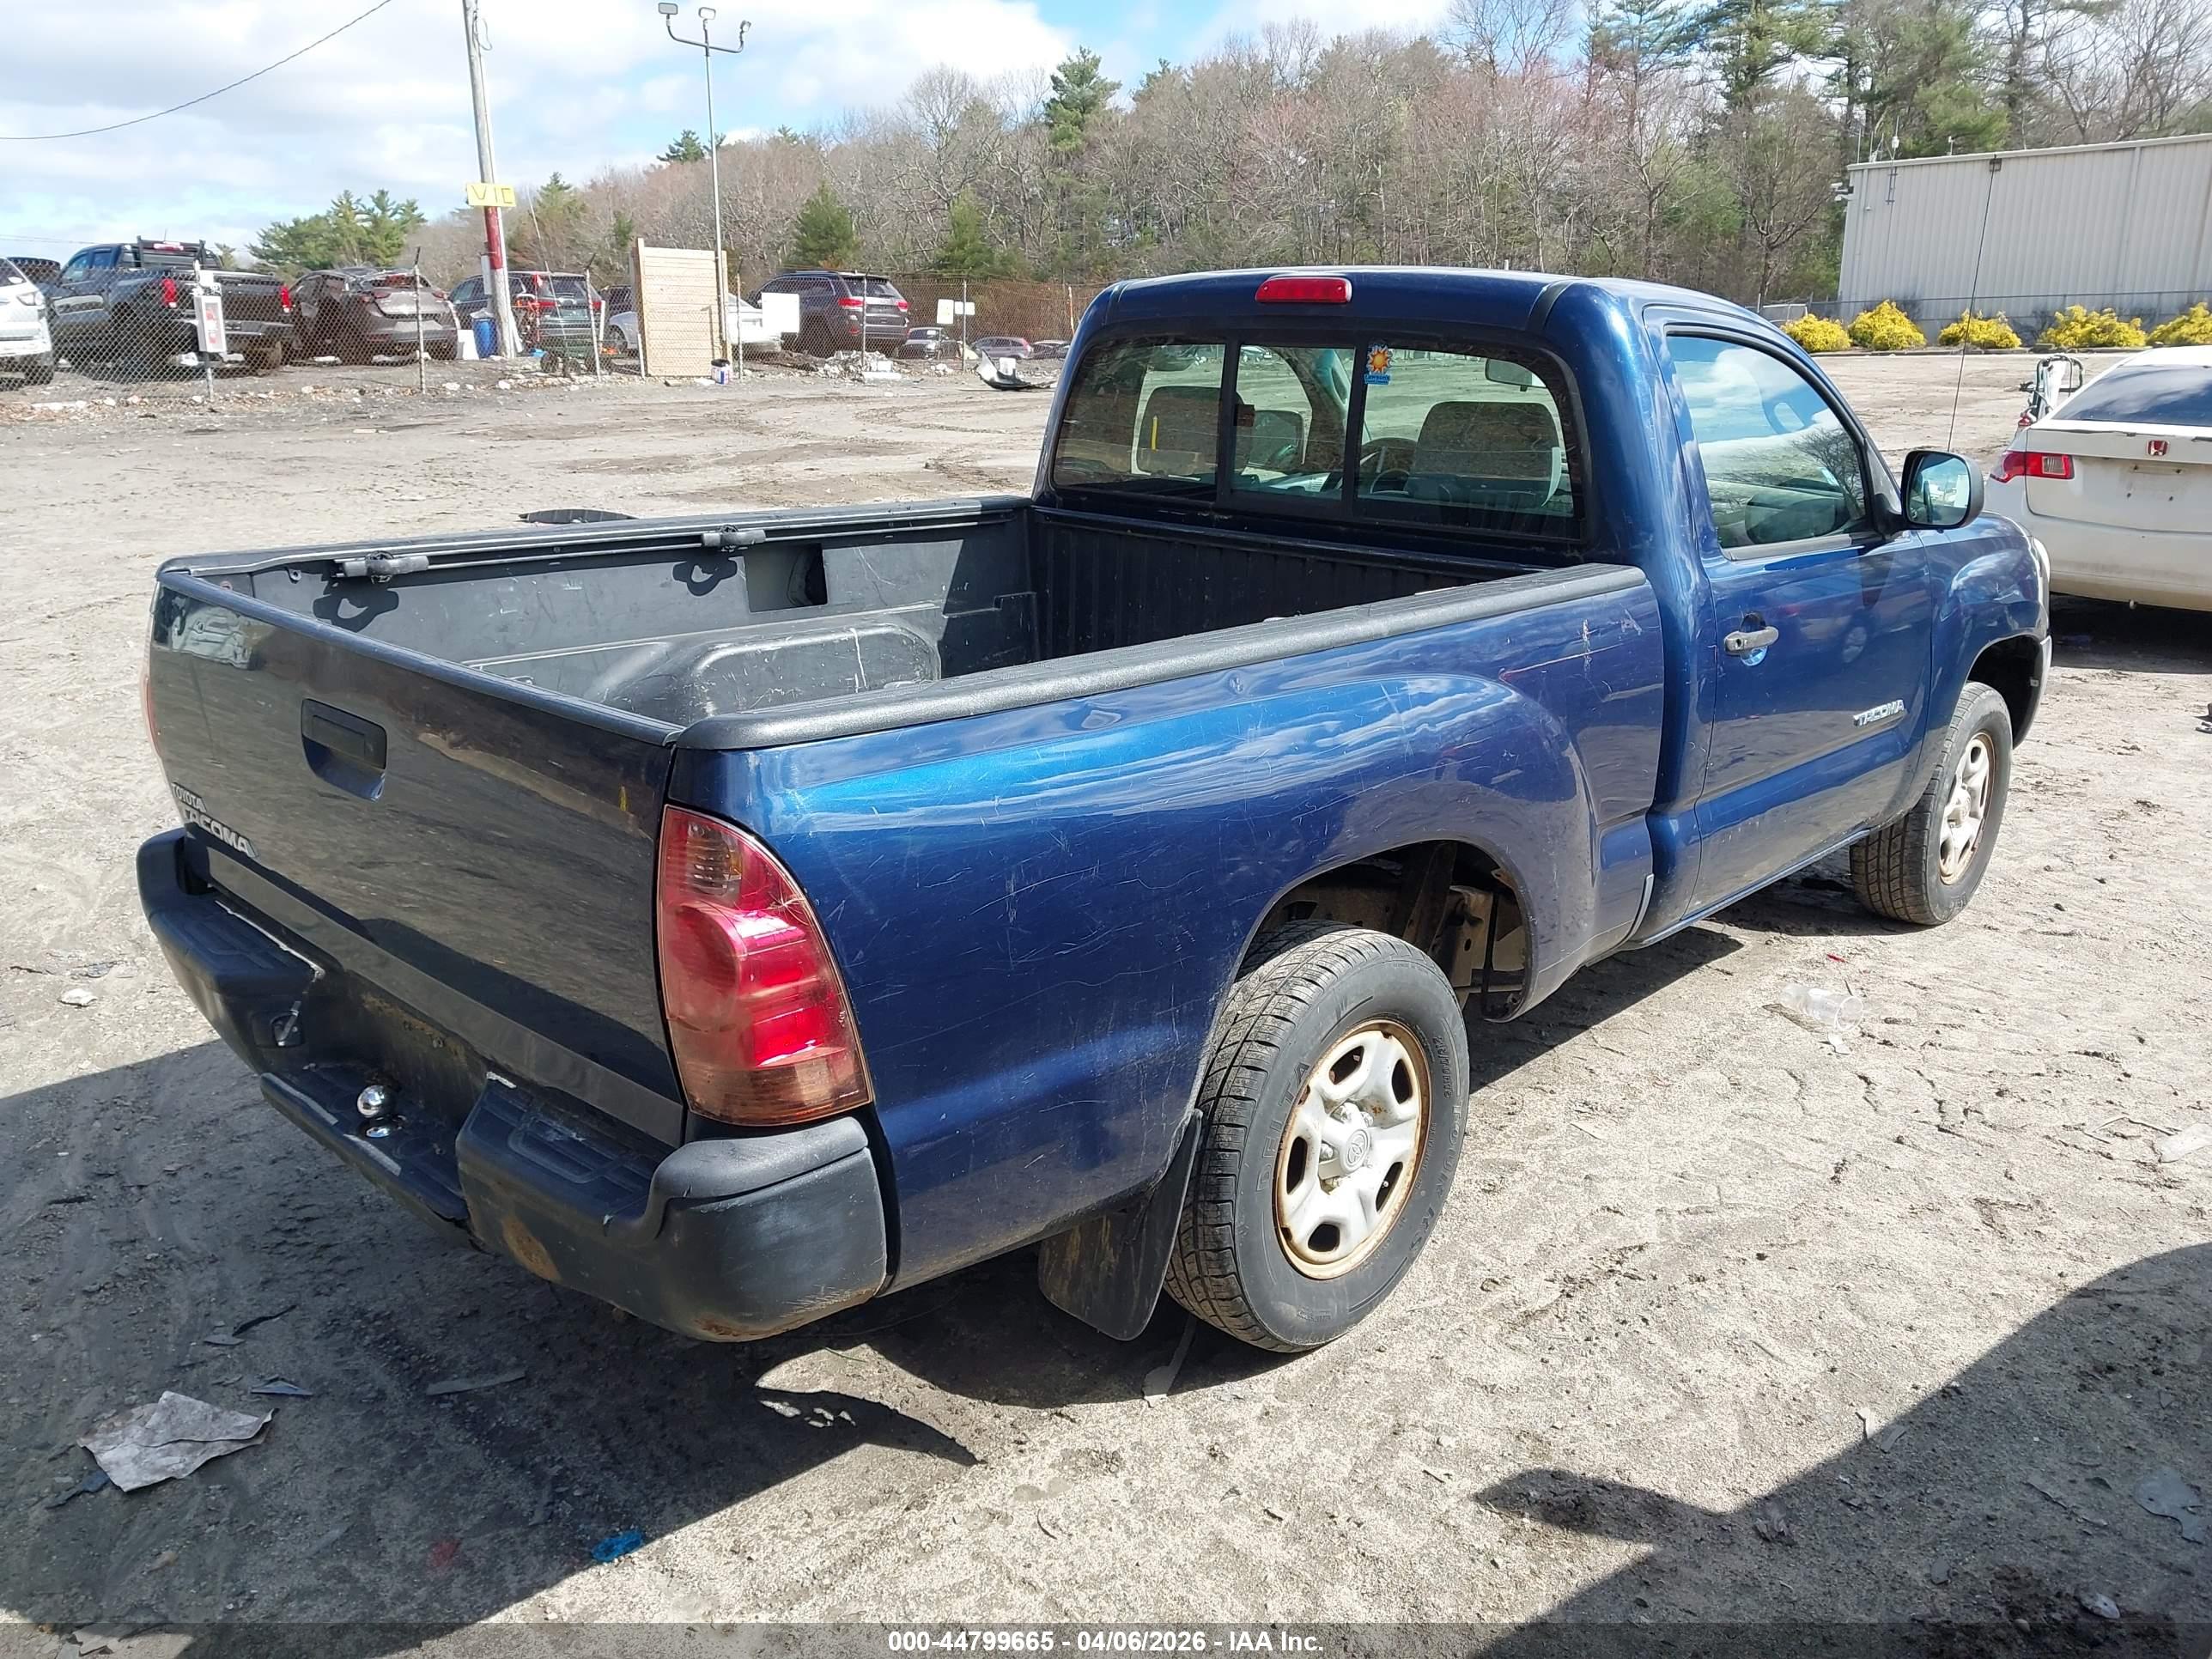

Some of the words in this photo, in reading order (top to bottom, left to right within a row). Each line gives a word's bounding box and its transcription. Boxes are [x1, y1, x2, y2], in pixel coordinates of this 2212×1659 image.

[471, 185, 514, 204] VIC
[1853, 699, 1905, 726] TACOMA
[171, 783, 207, 812] TOYOTA
[183, 807, 258, 858] TACOMA
[1256, 1061, 1312, 1192] DELTA
